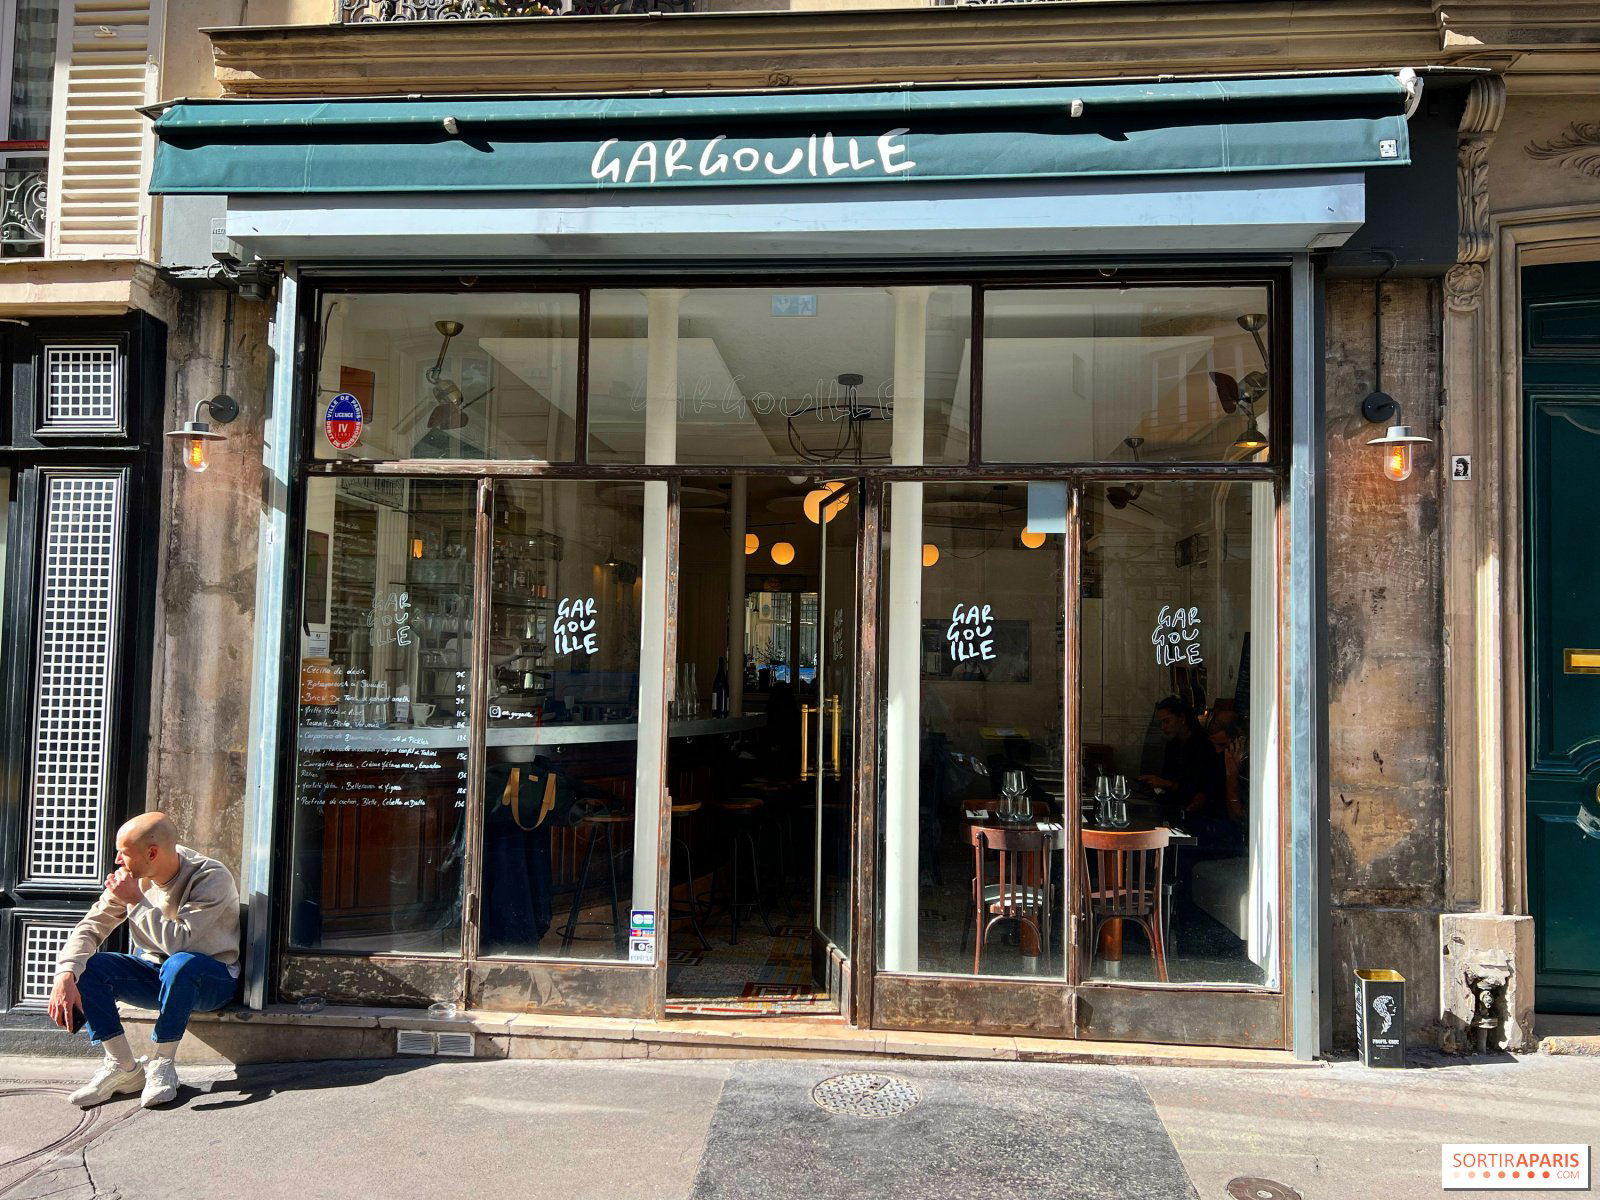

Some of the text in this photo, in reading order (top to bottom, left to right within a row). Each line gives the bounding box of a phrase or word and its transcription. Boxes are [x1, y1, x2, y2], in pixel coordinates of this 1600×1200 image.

[591, 128, 916, 183] GARGOUILLE
[327, 400, 339, 418] VILLE
[338, 424, 348, 432] IV
[372, 592, 411, 612] GAR
[558, 597, 597, 618] GAR
[952, 603, 994, 625] GAR
[1157, 605, 1201, 627] GAR
[553, 616, 596, 635] GOU
[947, 622, 992, 642] GOU
[1151, 624, 1200, 646] GOU
[554, 633, 599, 655] ILLE
[950, 640, 997, 661] ILLE
[1156, 643, 1204, 666] ILLE
